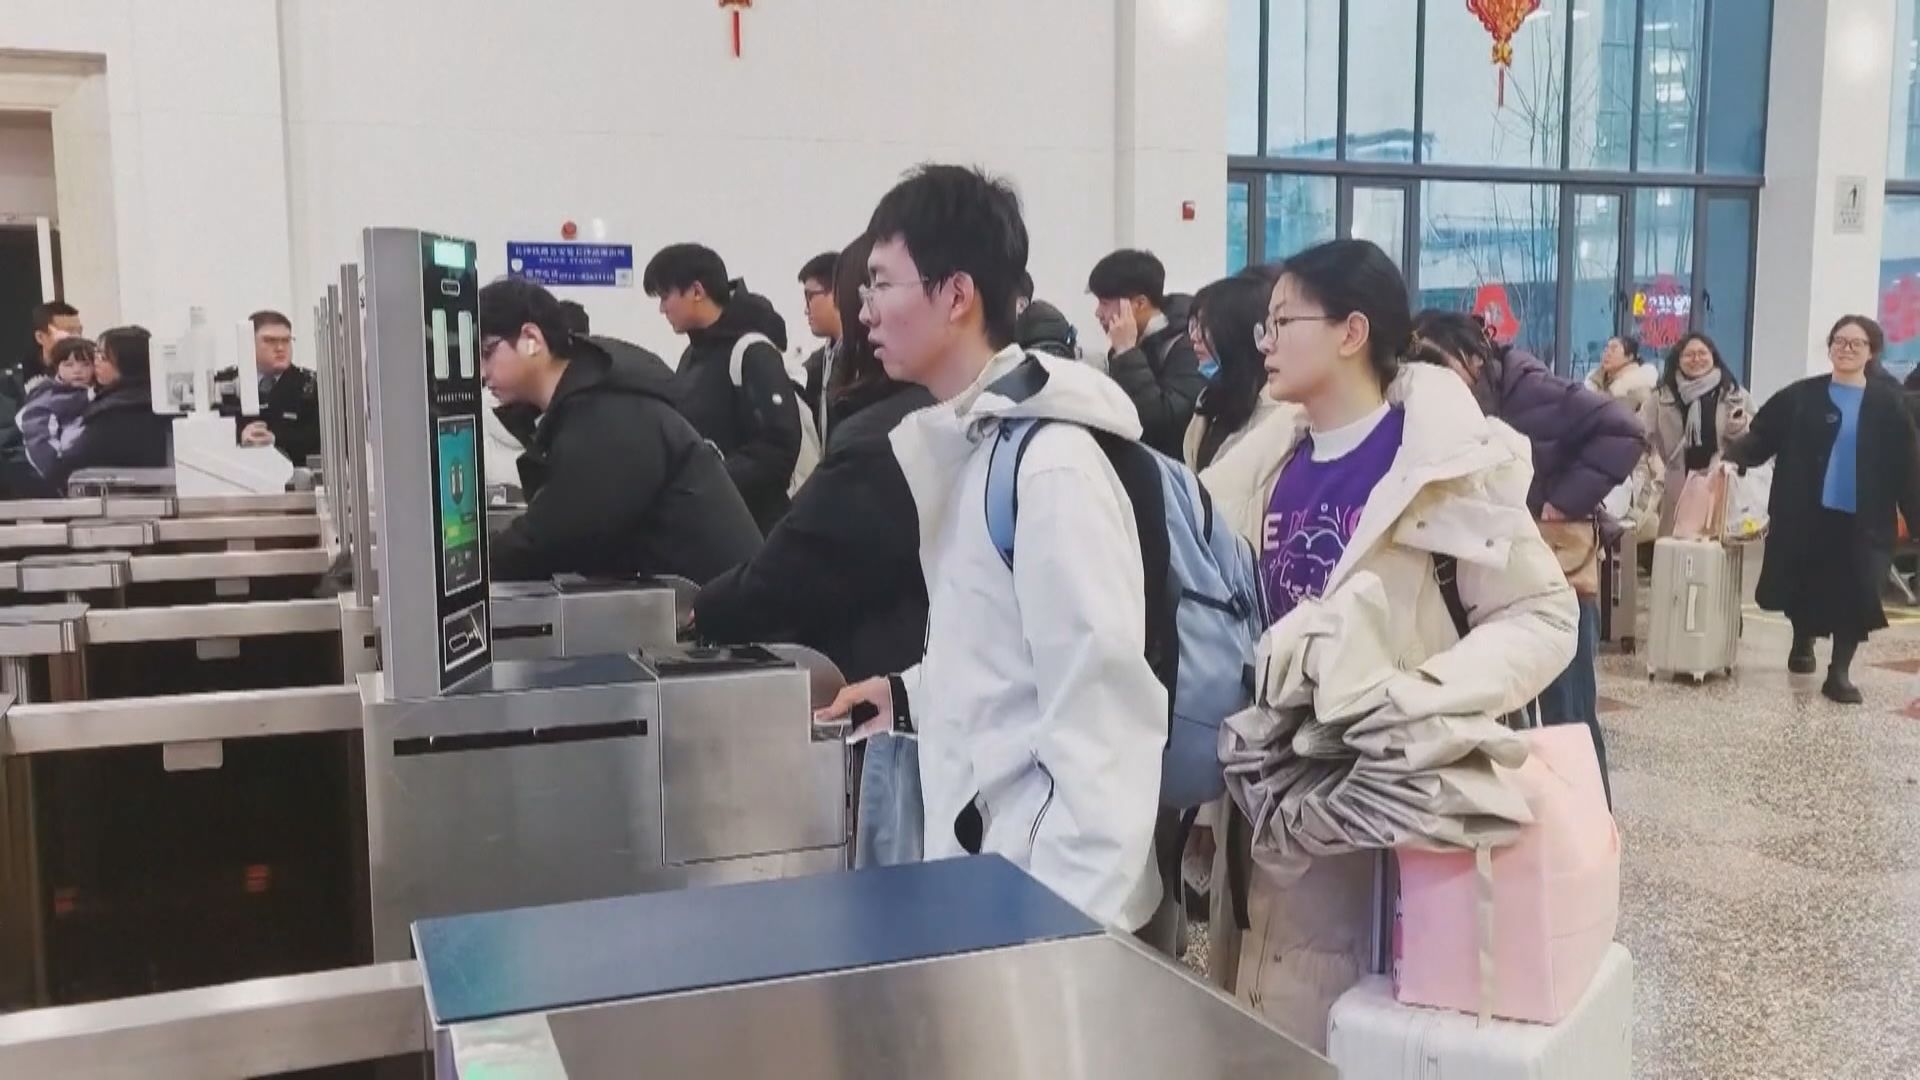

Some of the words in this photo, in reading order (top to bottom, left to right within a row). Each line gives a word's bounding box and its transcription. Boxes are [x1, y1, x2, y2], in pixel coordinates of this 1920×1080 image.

[539, 257, 566, 265] POLICE
[569, 257, 602, 266] STATION
[1263, 512, 1283, 550] E
